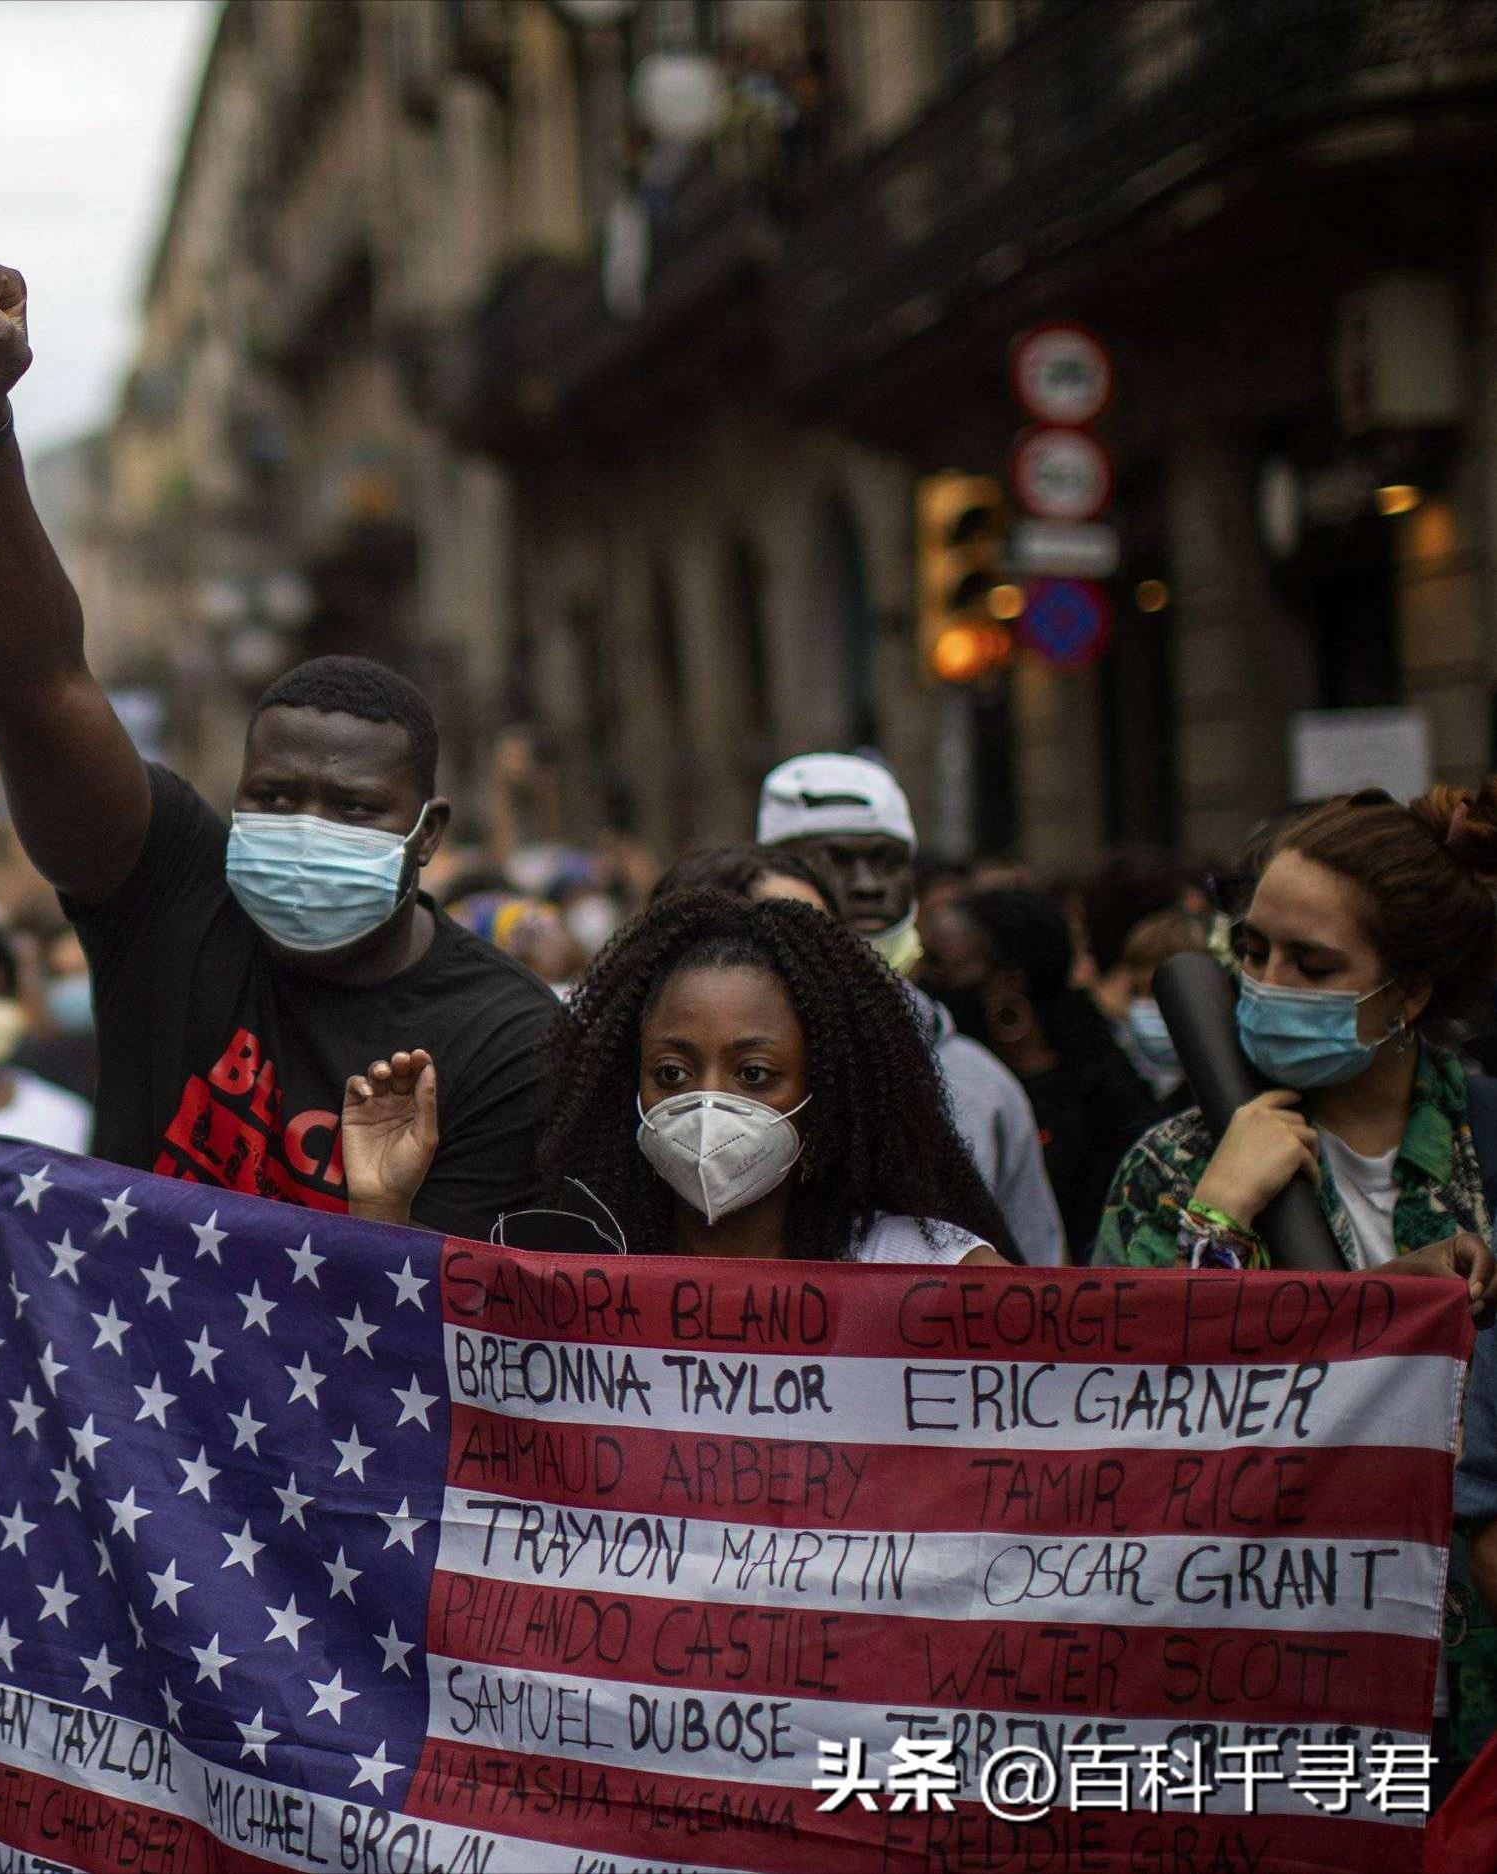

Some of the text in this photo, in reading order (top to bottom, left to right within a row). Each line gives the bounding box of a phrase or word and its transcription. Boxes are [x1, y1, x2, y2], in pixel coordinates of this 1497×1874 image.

[445, 1251, 1396, 1357] SANDRA BLAND GEORGE FLOYD
[455, 1331, 1329, 1438] BREONNA TAYLOR ERIC GARNER
[454, 1423, 1316, 1532] AHMAUD ARBERY TAMIR RICE
[467, 1500, 1400, 1610] TRAYVON MARTIN OSCAR GRANT
[442, 1574, 1350, 1712] PHILANDO CASTILE WALTER SCOTT
[447, 1664, 615, 1750] SAMUEL
[628, 1692, 796, 1764] DUBOSE
[50, 1702, 178, 1794] TAYLOR
[204, 1766, 328, 1865] MICHAEL
[340, 1804, 495, 1874] BROWN
[420, 1748, 611, 1820] NATASHA
[883, 1810, 1111, 1874] FREDDIE
[1128, 1822, 1272, 1874] GRAY
